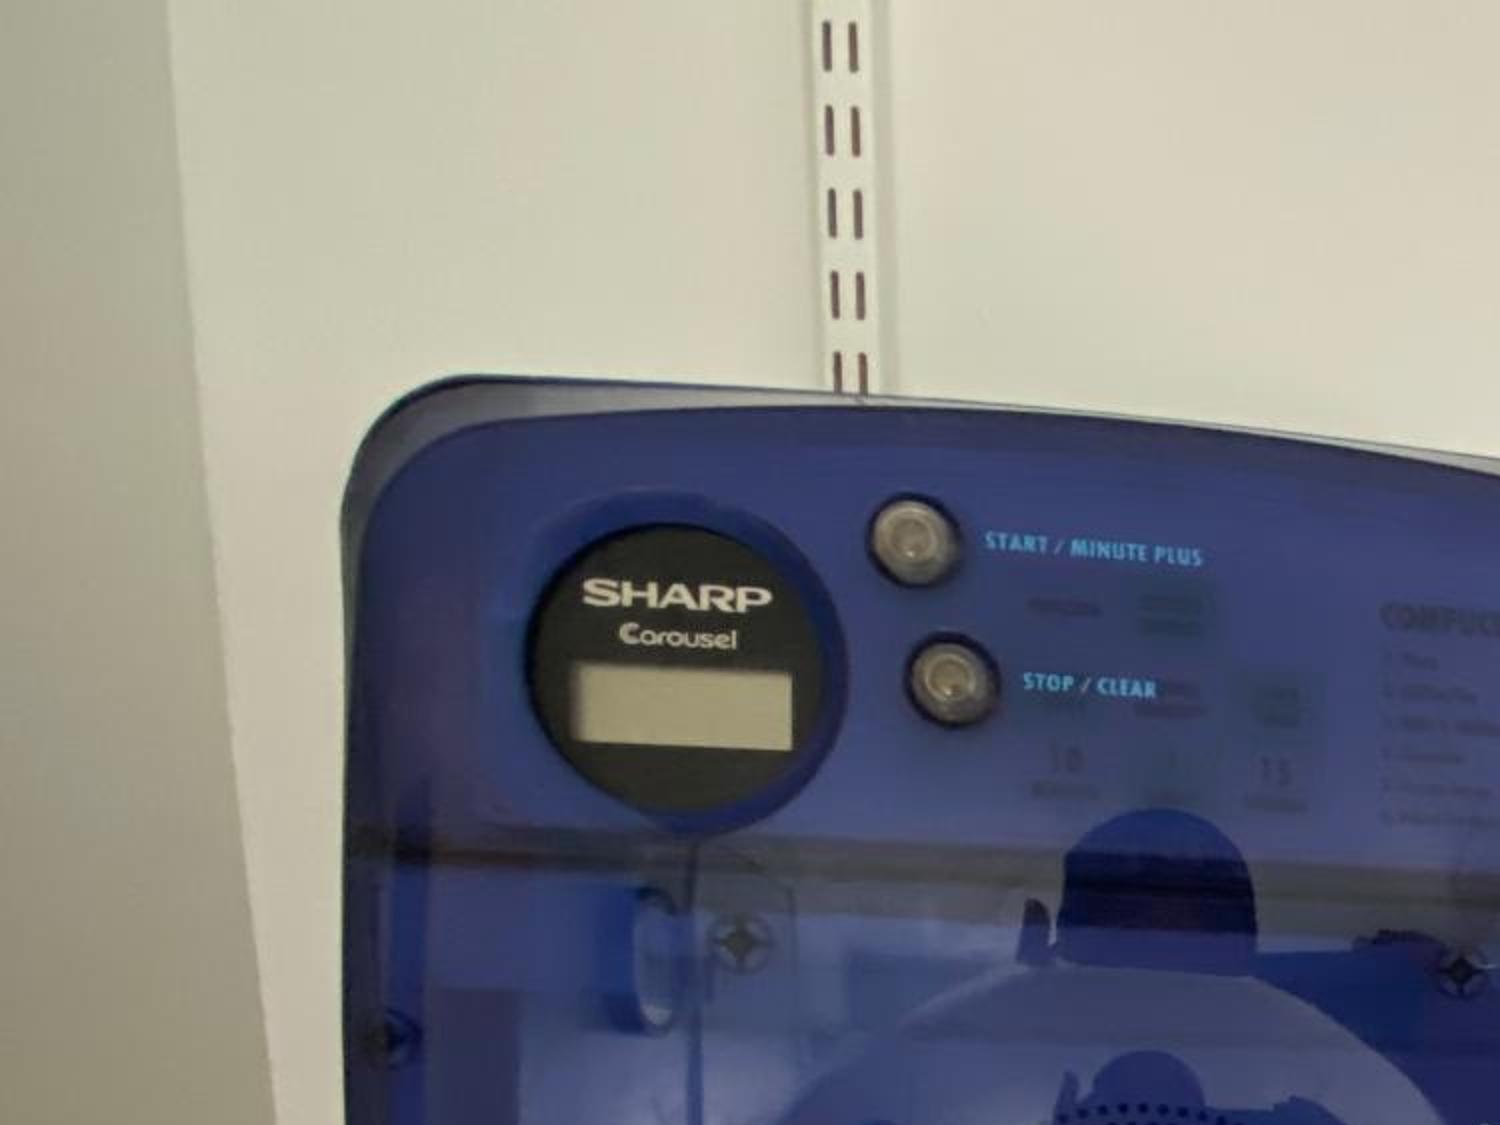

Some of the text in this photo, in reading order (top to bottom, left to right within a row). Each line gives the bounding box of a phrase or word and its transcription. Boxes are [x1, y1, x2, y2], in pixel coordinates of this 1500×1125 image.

[985, 530, 1049, 554] START
[1070, 538, 1147, 562] MINUTE
[1155, 545, 1204, 567] PLUS
[583, 577, 773, 613] SHARP
[619, 621, 738, 650] Carousel
[1022, 671, 1075, 692] STOP
[1096, 676, 1157, 699] CLEAR
